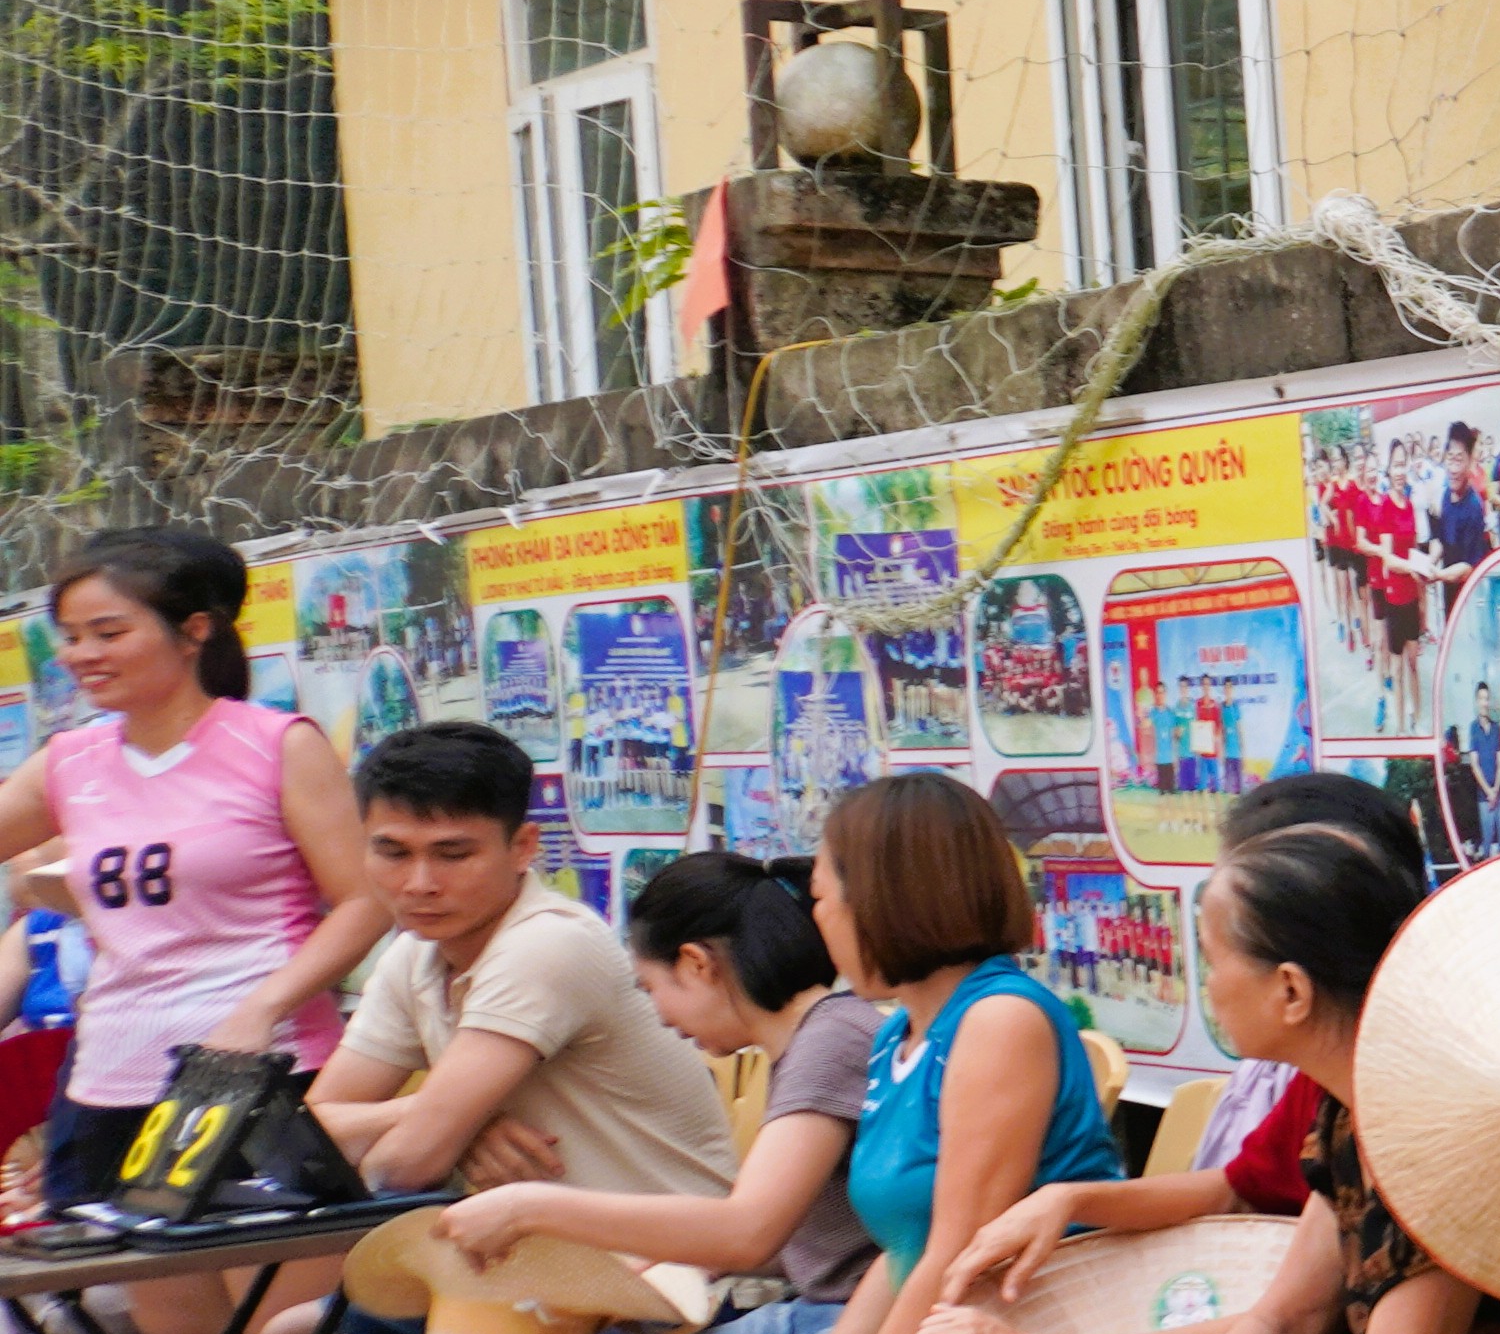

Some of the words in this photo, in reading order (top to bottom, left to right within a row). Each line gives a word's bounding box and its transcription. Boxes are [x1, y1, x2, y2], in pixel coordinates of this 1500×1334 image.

[1102, 448, 1173, 493] CƯỜNG
[1179, 438, 1246, 486] QUYÊN
[91, 842, 171, 909] 88
[119, 1099, 179, 1180] 8
[166, 1103, 230, 1186] 2
